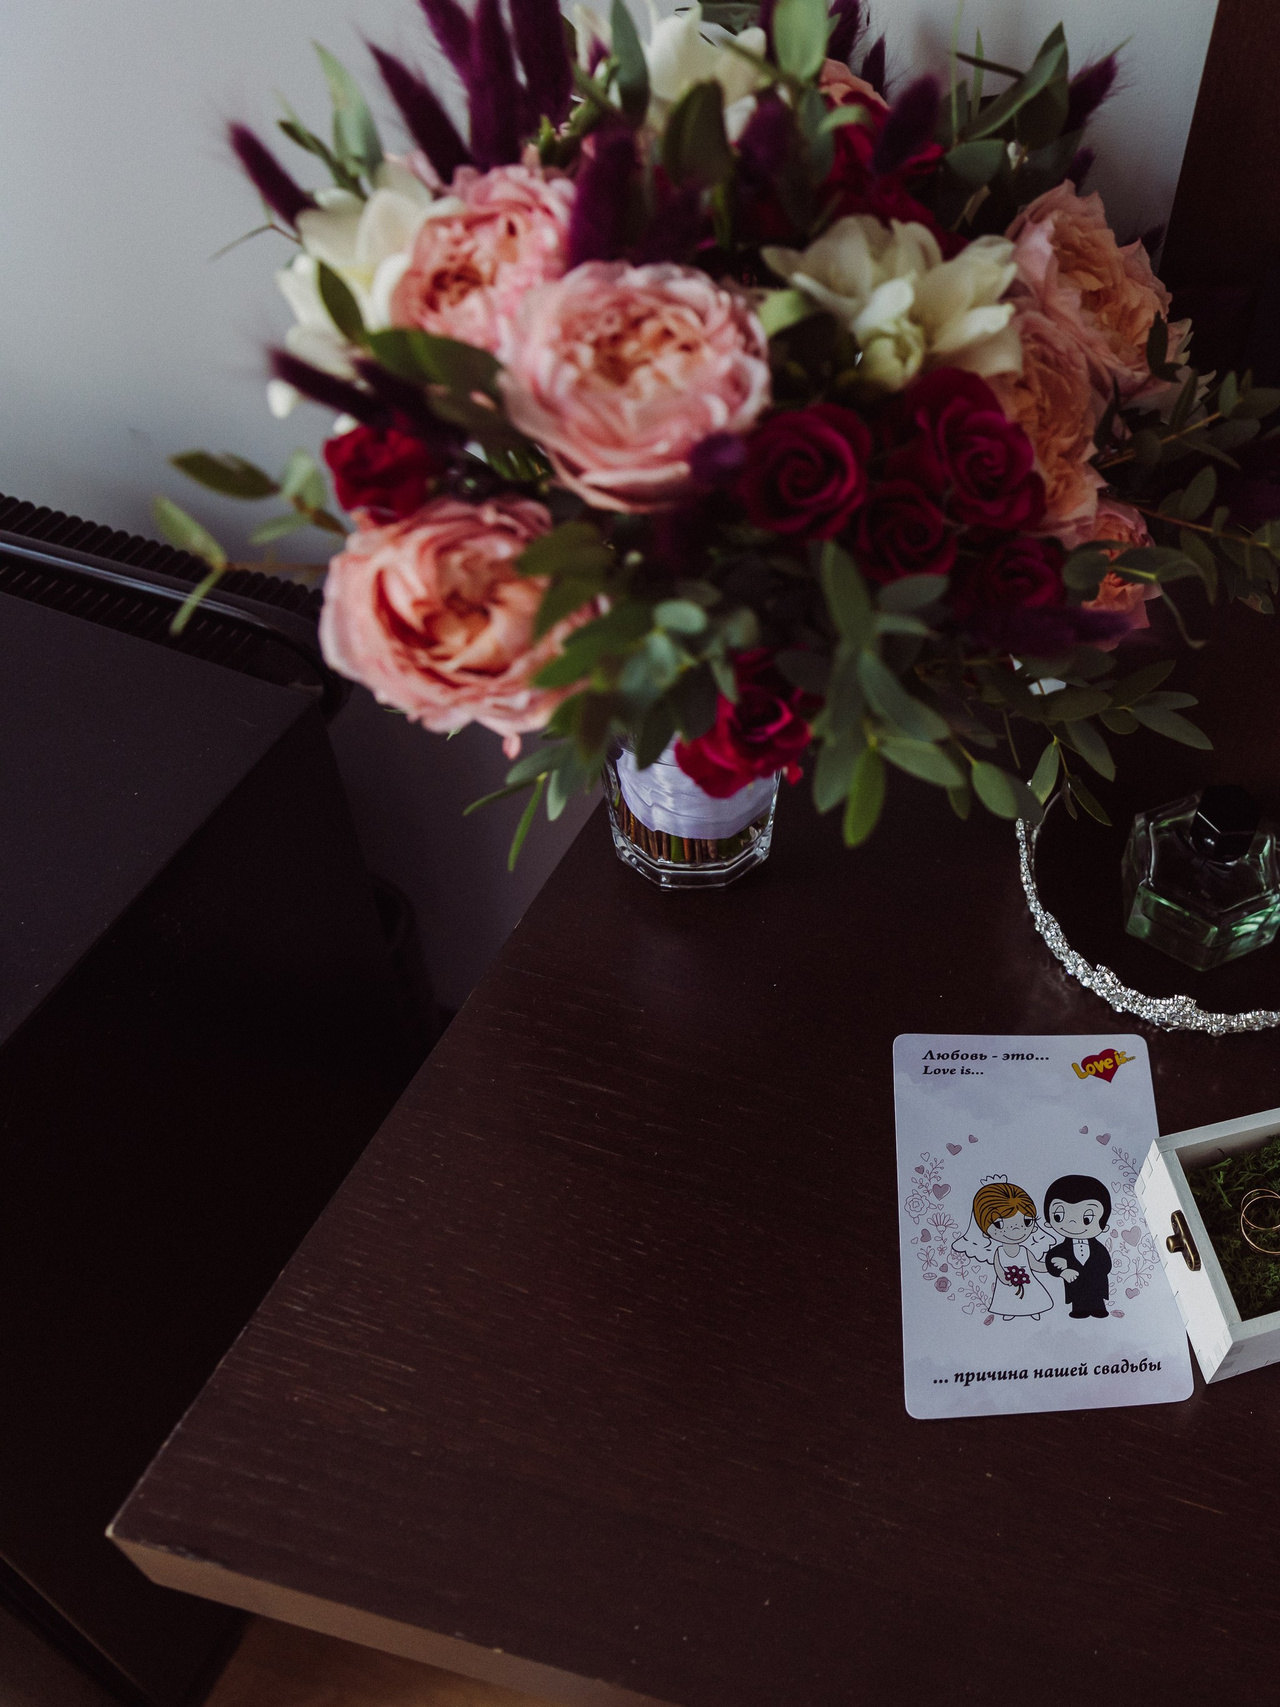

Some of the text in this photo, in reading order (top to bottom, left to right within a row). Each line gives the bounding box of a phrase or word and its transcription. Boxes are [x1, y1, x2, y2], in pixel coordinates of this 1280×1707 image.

[921, 1049, 988, 1061] Любовь
[1001, 1052, 1050, 1061] это...
[922, 1065, 984, 1075] Love is...
[1071, 1056, 1114, 1080] Love
[954, 1368, 1029, 1387] причина
[1033, 1362, 1089, 1379] нашей
[1093, 1357, 1162, 1376] свадьбы
